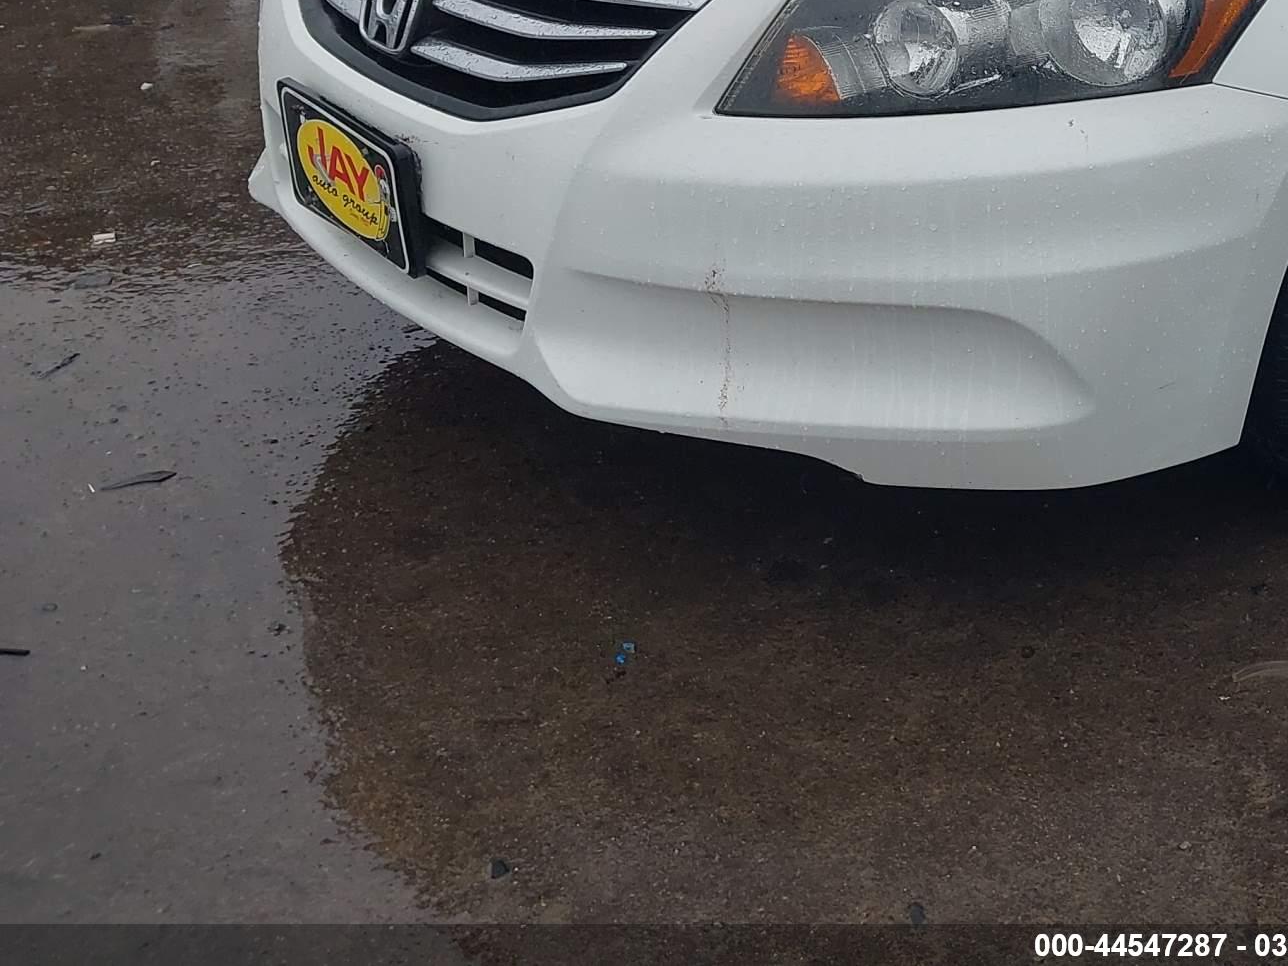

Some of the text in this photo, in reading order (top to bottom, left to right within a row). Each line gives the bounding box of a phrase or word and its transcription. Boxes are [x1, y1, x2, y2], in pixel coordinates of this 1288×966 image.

[307, 126, 370, 202] JAY
[312, 174, 339, 197] auto
[342, 194, 379, 226] group
